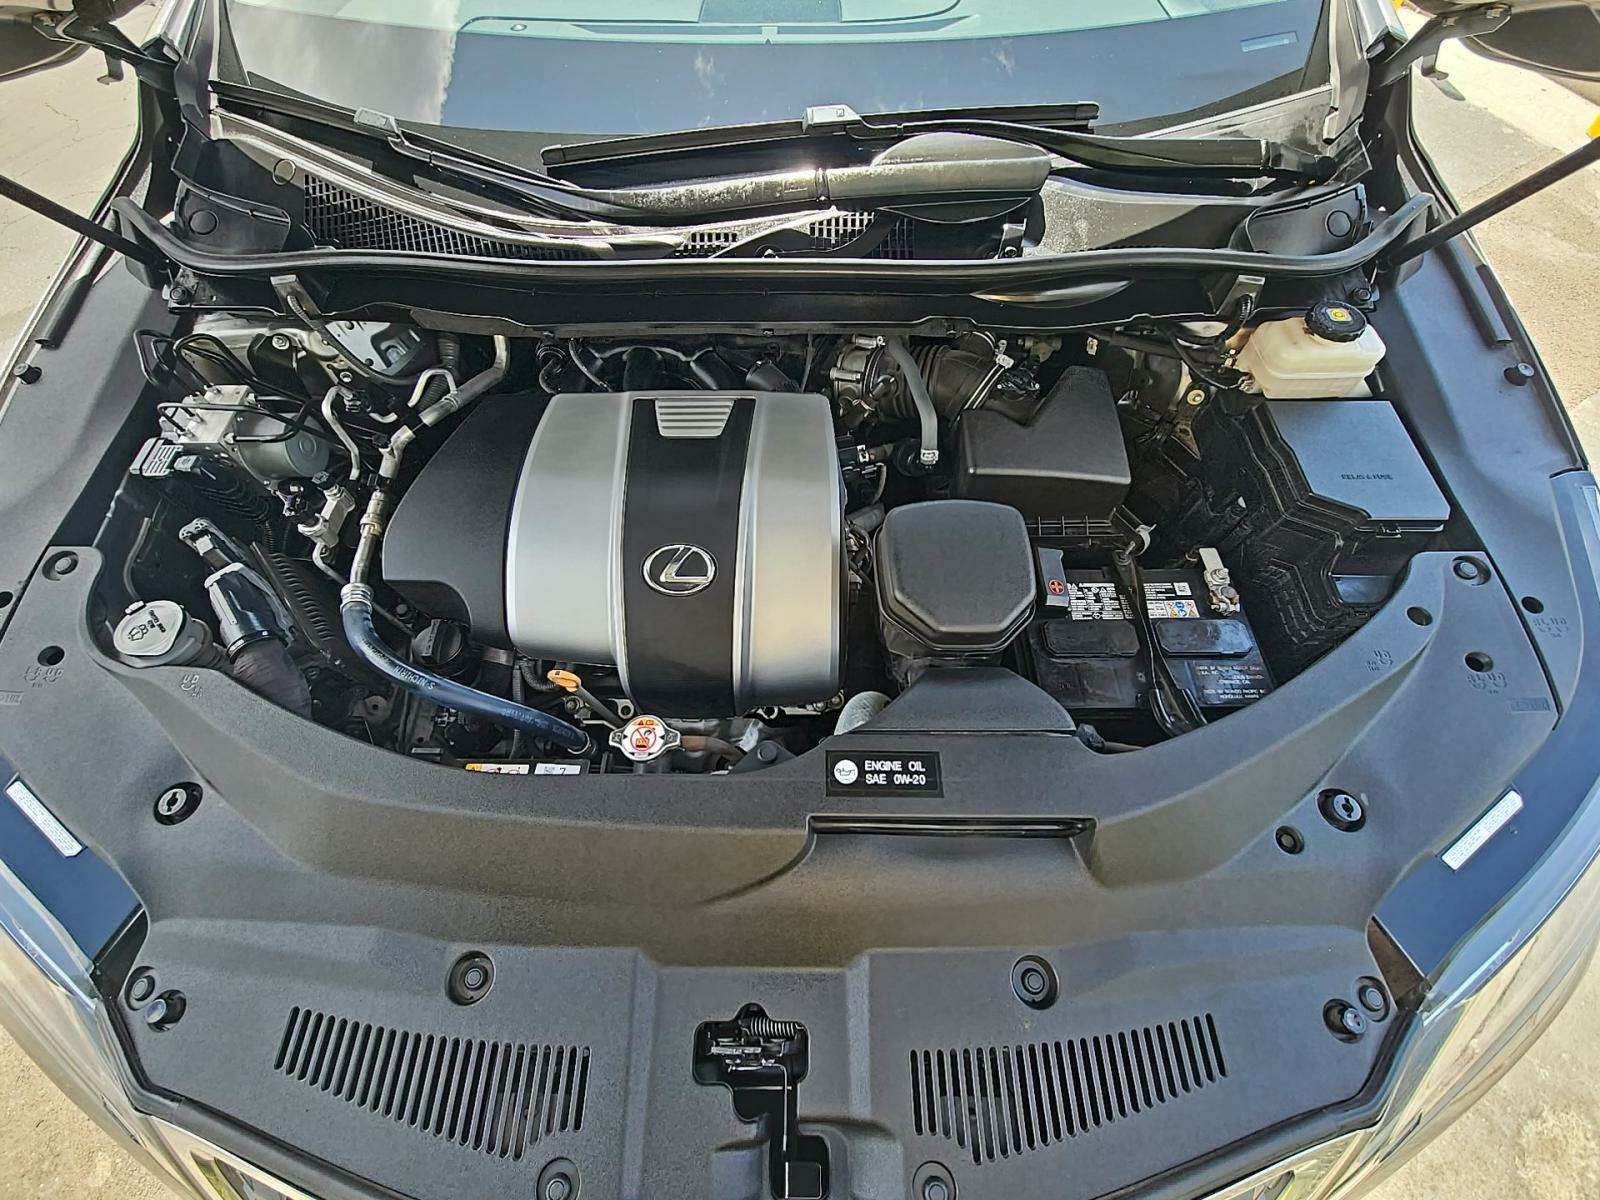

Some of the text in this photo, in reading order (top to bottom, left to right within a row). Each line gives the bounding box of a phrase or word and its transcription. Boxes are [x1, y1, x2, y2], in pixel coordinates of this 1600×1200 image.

[864, 760, 926, 772] ENGINE OIL
[865, 773, 926, 786] SAE 0W-20
